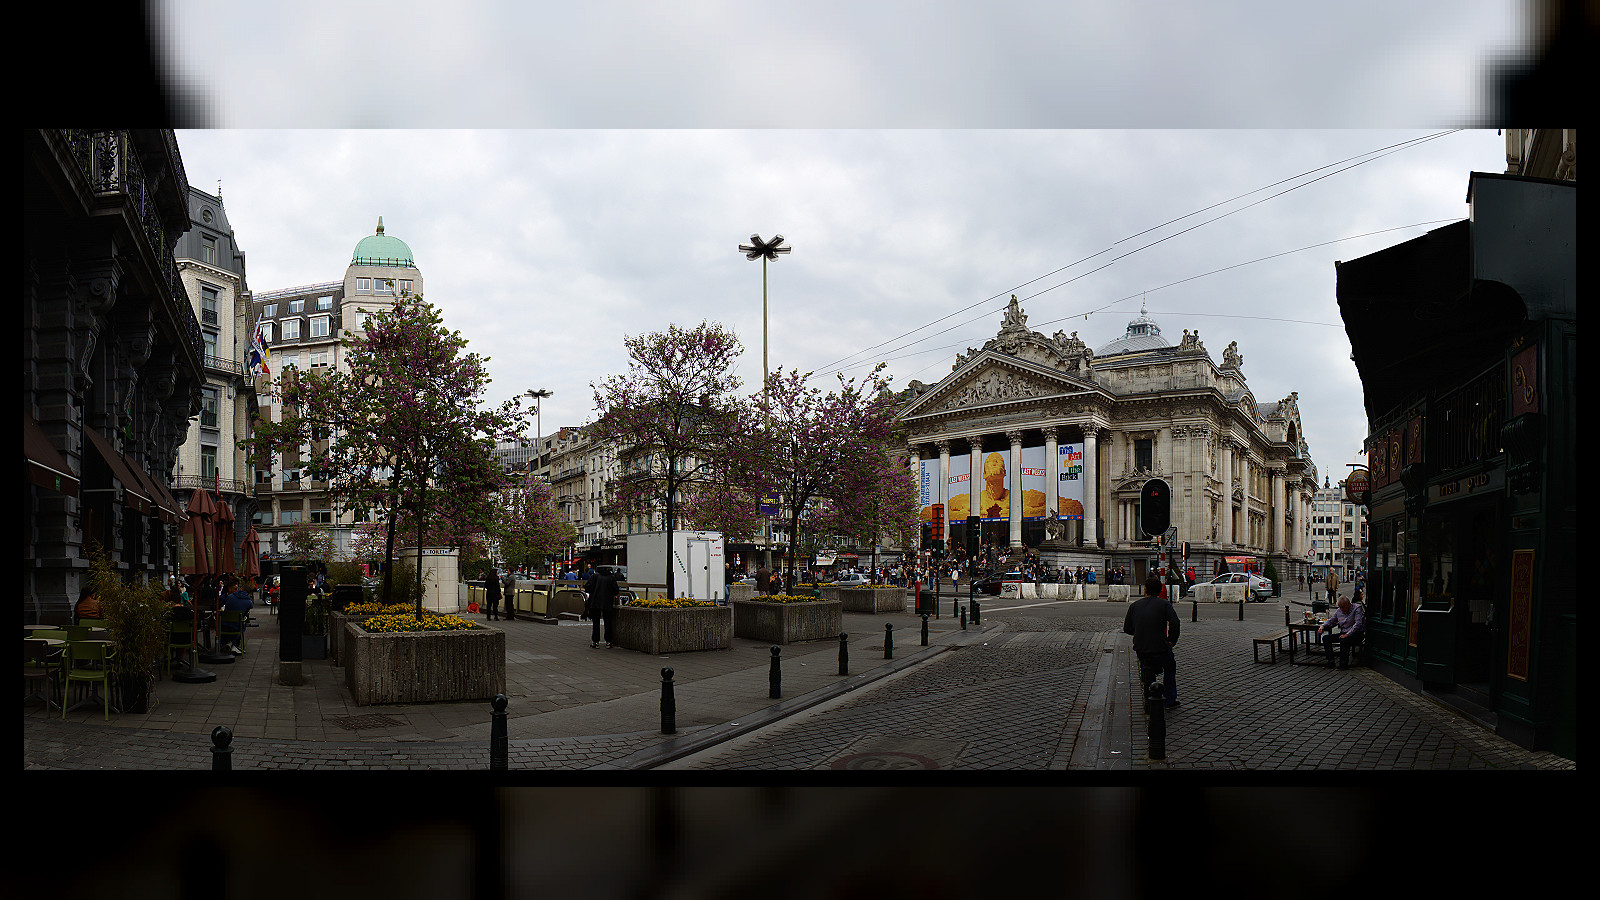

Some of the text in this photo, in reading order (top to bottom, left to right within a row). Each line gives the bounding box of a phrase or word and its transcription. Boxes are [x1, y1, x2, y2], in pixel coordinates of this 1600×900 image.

[1060, 446, 1073, 455] The
[1068, 452, 1082, 460] Art
[1060, 473, 1078, 481] Brick
[1467, 471, 1487, 492] pub
